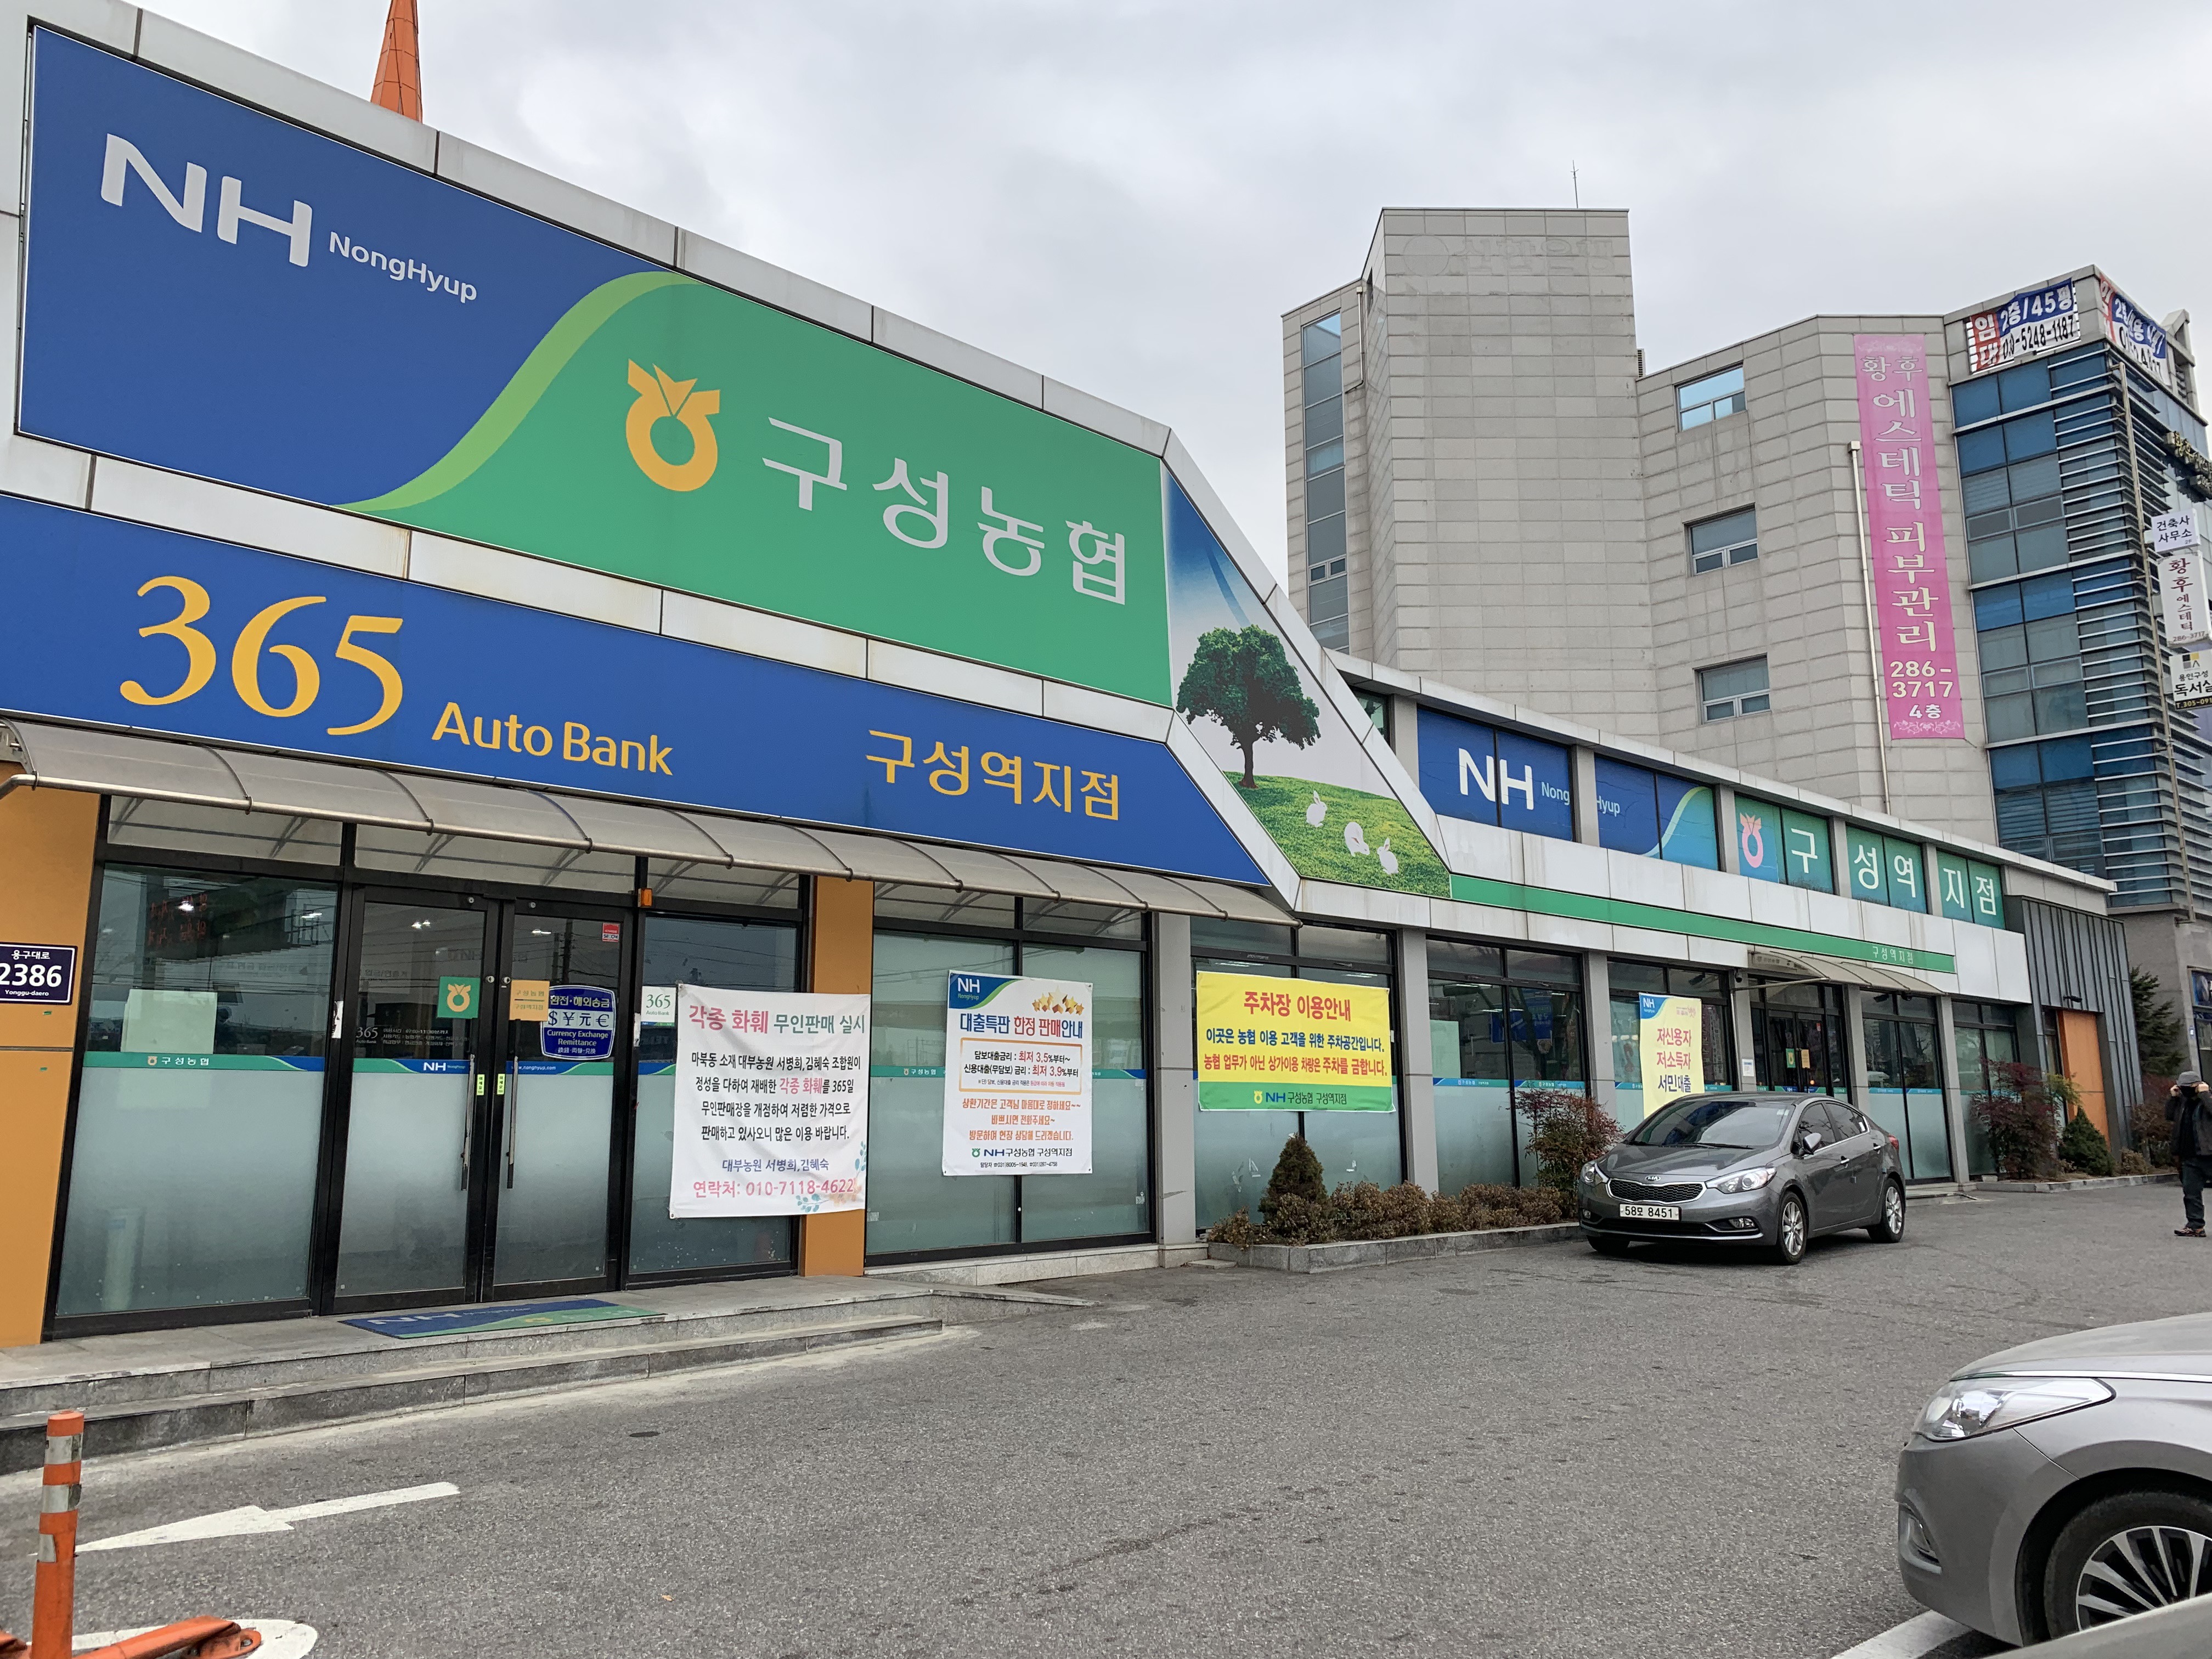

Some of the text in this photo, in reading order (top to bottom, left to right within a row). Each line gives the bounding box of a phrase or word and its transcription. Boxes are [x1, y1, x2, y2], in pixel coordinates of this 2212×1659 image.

[100, 133, 477, 303] NH NongHyup
[2003, 314, 2073, 359] 00-5248-1187
[1862, 356, 1923, 381] 황후
[1872, 387, 1922, 510] 에스테틱
[762, 417, 1126, 605] 구성농협
[2157, 515, 2190, 531] 건축사
[2159, 529, 2192, 543] 사무소
[1883, 521, 1939, 652] 피부관리
[2172, 631, 2205, 642] 286-3717
[120, 575, 673, 775] 365 Auto Bank
[1889, 661, 1952, 678] 286-
[2179, 670, 2208, 681] 용인구성
[1892, 681, 1954, 698] 3717
[1909, 704, 1942, 719] 4층
[866, 730, 1119, 821] 구성역지점
[1458, 747, 1534, 810] NH
[1790, 827, 1997, 916] 구성역지점
[12, 950, 50, 960] 용구대로
[1872, 946, 1913, 964] 구성역지점
[0, 963, 62, 988] 2386
[957, 978, 980, 993] NH
[646, 994, 670, 1009] 365
[1244, 991, 1351, 1022] 주차장 이용안내
[1643, 997, 1655, 1009] NH
[689, 1005, 865, 1034] 각종 화훼 무인판매 실시
[960, 1013, 1083, 1039] 대출특판 한정 판매안내
[356, 1026, 379, 1039] 365
[548, 1030, 608, 1039] Currency Exchange
[1206, 1028, 1385, 1052] 이곳은 농협 이용 고객을 위한 주차공간입니다.
[1657, 1028, 1691, 1047] 저신용자
[161, 1056, 210, 1066] 구성농협
[692, 1052, 861, 1071] 마북동 소재 대부농원 서병희,김혜숙 조합원이
[974, 1051, 1012, 1061] 담보대출금리
[1019, 1051, 1034, 1062] 최저
[1204, 1053, 1387, 1076] 농협 업무가 아닌 상가이용 차량은 주차를 금합니다.
[1657, 1051, 1691, 1070] 저소득자
[423, 1062, 446, 1071] NH
[964, 1064, 1079, 1077] 신용대출(무담보) 금리 최저 3.9%부터
[696, 1076, 854, 1094] 정성을 다하여 재배한 각종 화훼를 365일
[1658, 1074, 1691, 1093] 서민대출
[962, 1098, 997, 1109] 상환기간은
[1000, 1099, 1019, 1110] 고객님
[1022, 1100, 1045, 1110] 마음대로
[1266, 1092, 1347, 1105] NH 구성농협 구성역지점
[701, 1101, 851, 1118] 무인판매장을 개점하여 저렴한 가격으로
[991, 1115, 1018, 1125] 바쁘시면
[701, 1125, 849, 1142] 판매하고 있사오니 많은 이용 바랍니다.
[969, 1130, 1074, 1141] 방문하여 현장 상담해 드리겠습니다.
[1037, 1148, 1073, 1156] 구성역지점
[722, 1158, 829, 1172] 대부농원 서병희,김혜숙
[693, 1178, 854, 1198] 연락처: 010-7118-4622
[1626, 1206, 1672, 1218] 58모 8451
